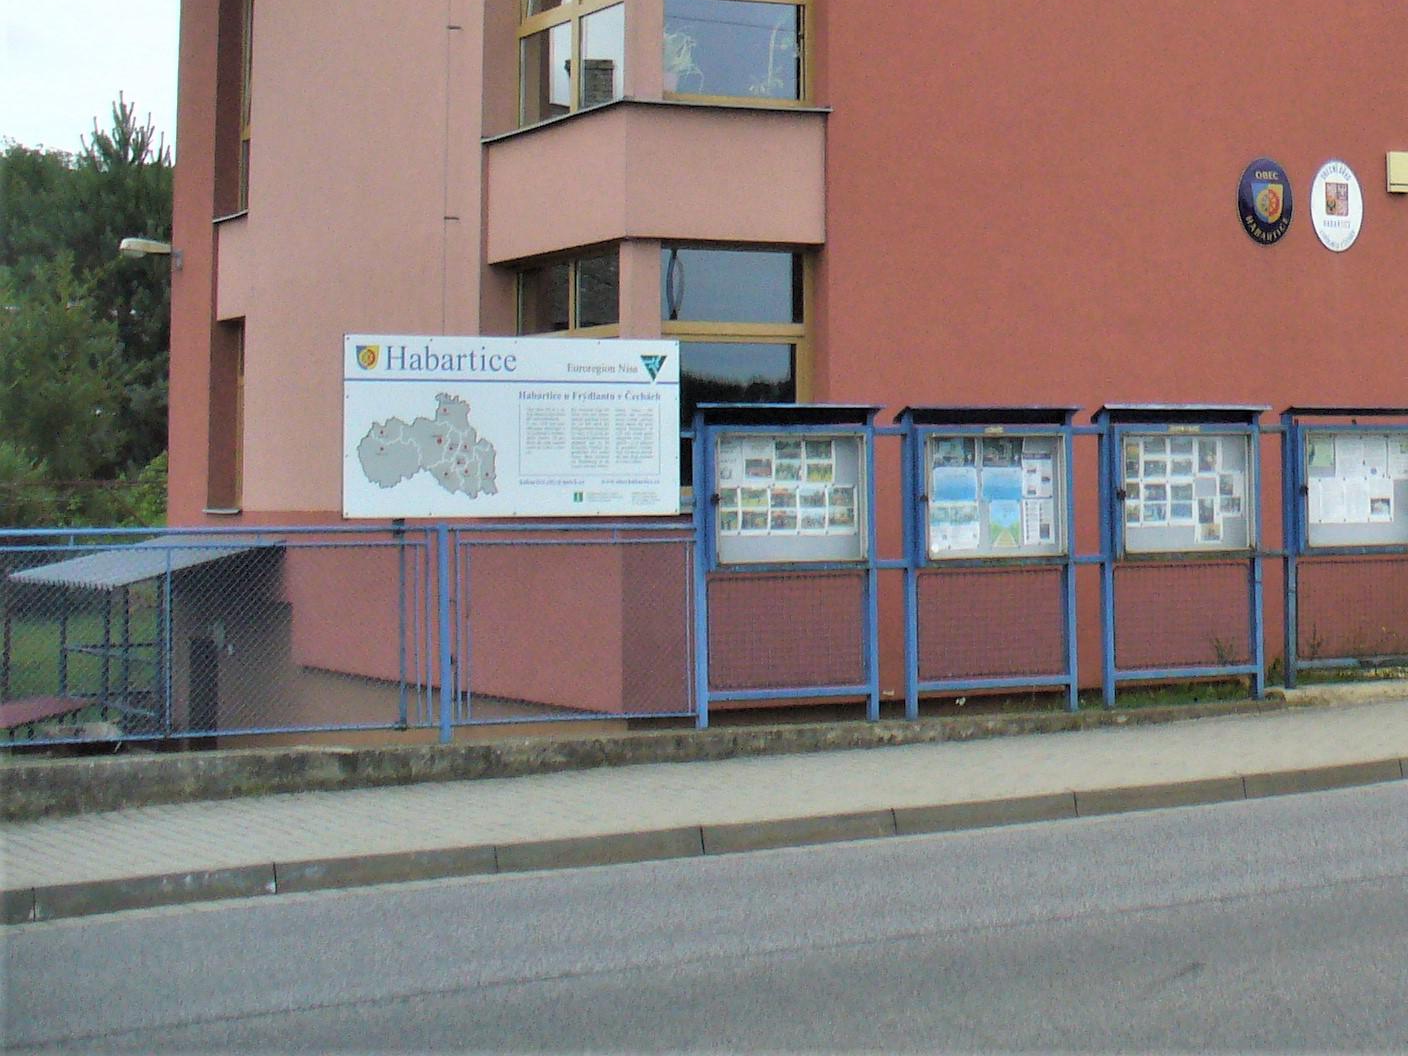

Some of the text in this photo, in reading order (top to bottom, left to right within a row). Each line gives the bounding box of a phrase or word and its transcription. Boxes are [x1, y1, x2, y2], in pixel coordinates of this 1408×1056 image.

[1255, 170, 1280, 180] OBEC
[1244, 215, 1289, 242] HABARTICE
[384, 345, 518, 372] Habartice
